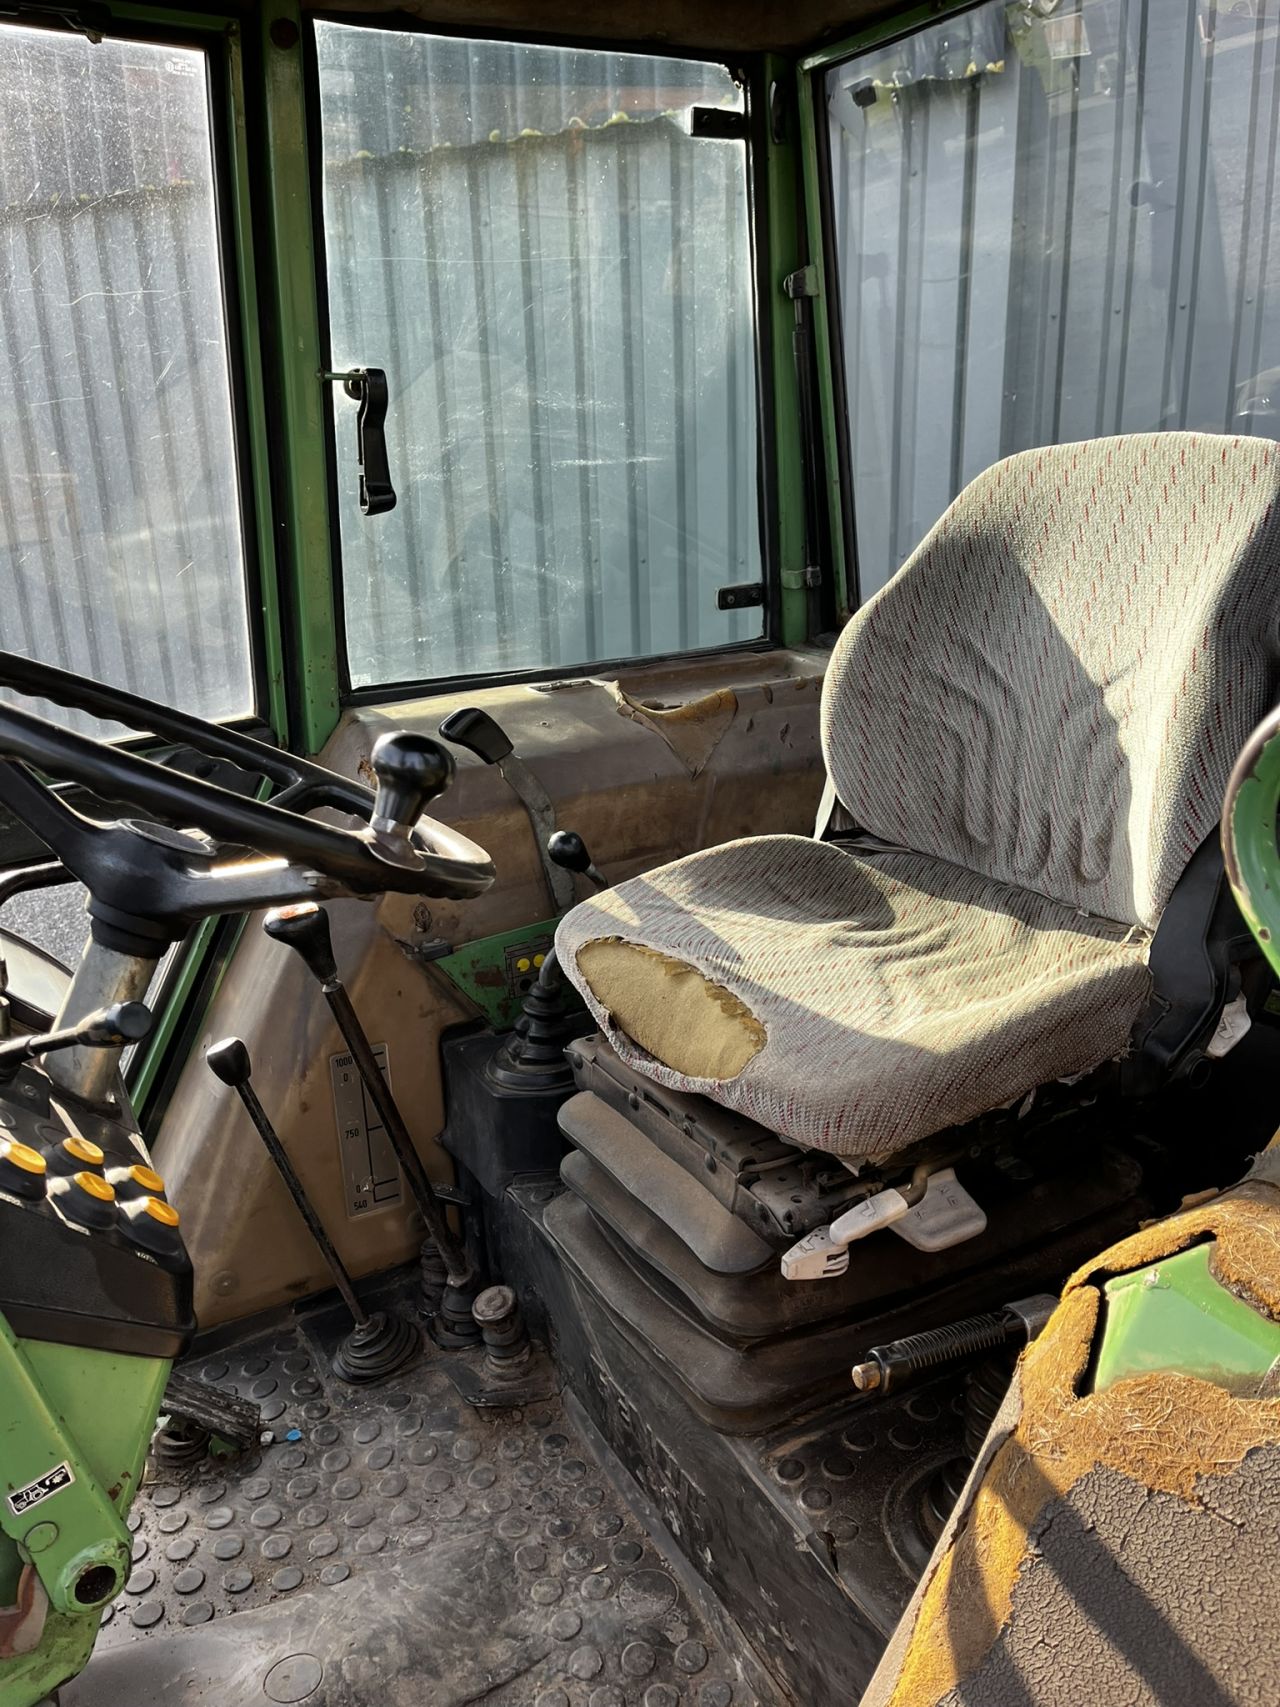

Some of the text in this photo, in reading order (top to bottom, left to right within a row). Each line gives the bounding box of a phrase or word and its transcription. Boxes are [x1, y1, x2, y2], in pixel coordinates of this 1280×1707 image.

[335, 1056, 353, 1068] 1000
[345, 1128, 359, 1140] 750
[353, 1200, 368, 1210] 540
